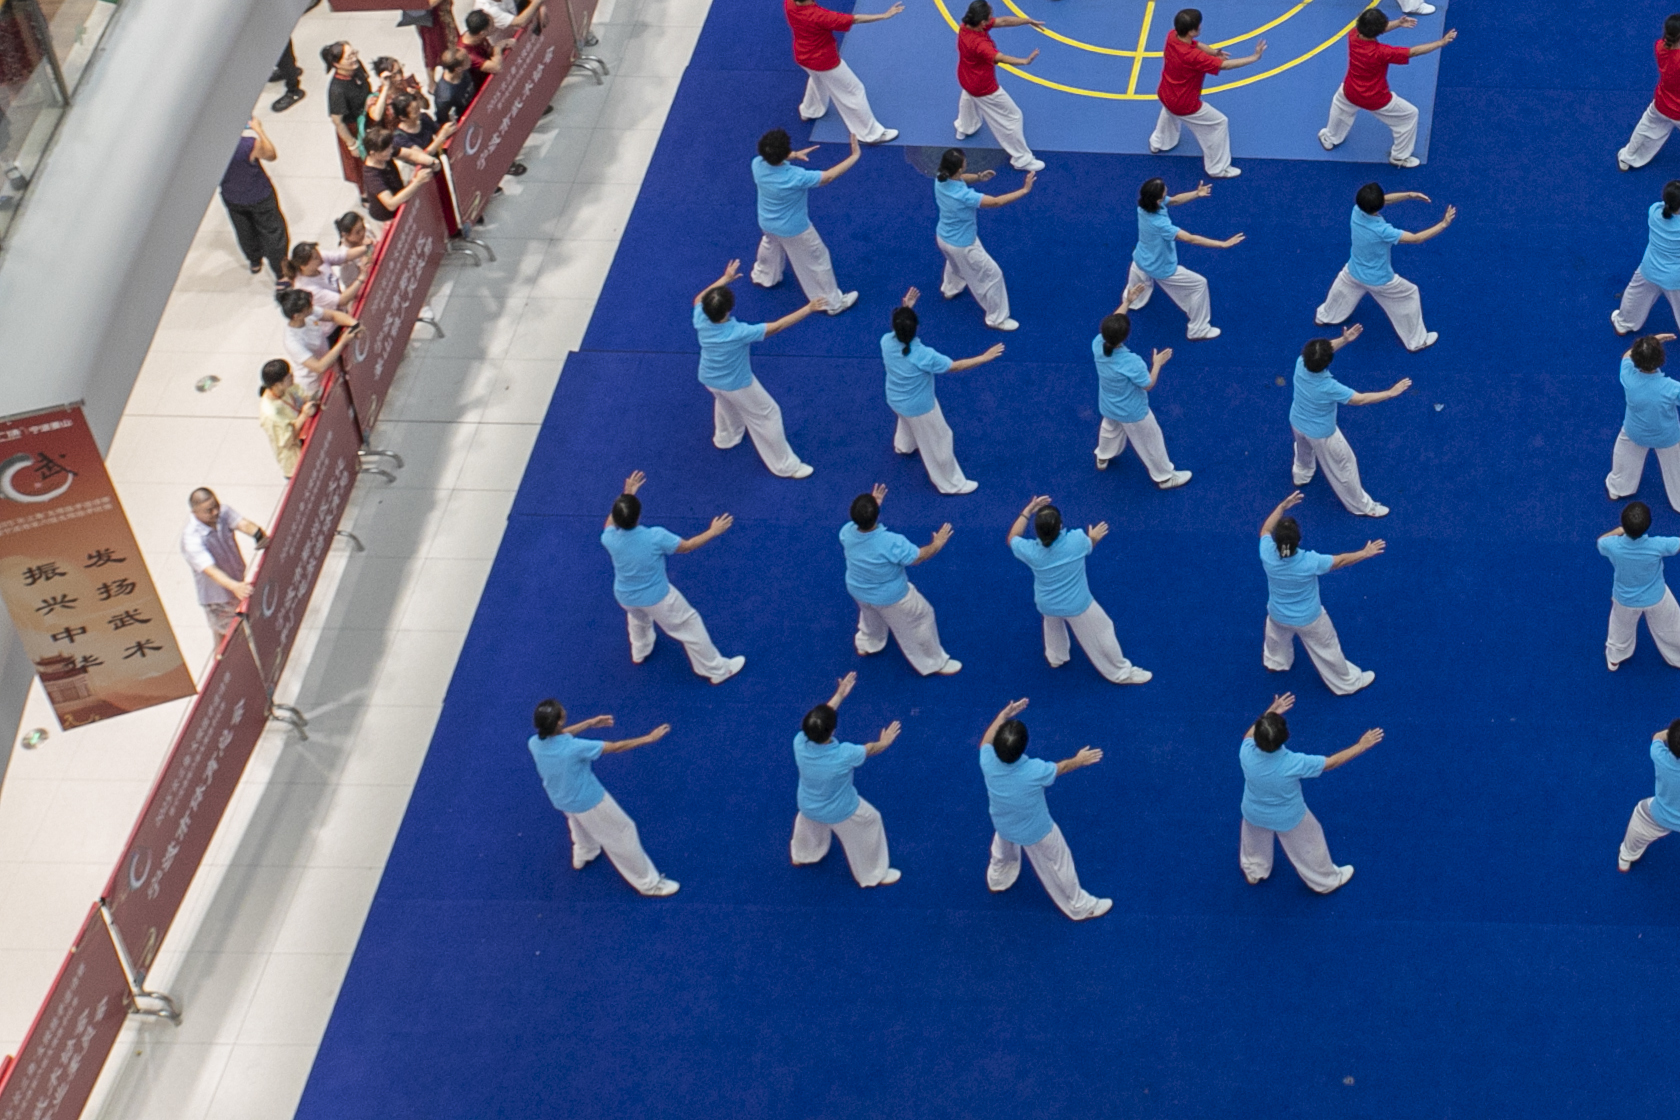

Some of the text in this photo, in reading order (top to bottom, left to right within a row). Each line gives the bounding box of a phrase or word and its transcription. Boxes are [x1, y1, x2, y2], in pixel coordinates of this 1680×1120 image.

[22, 561, 104, 673] 振兴中华
[84, 548, 163, 661] 发扬武术
